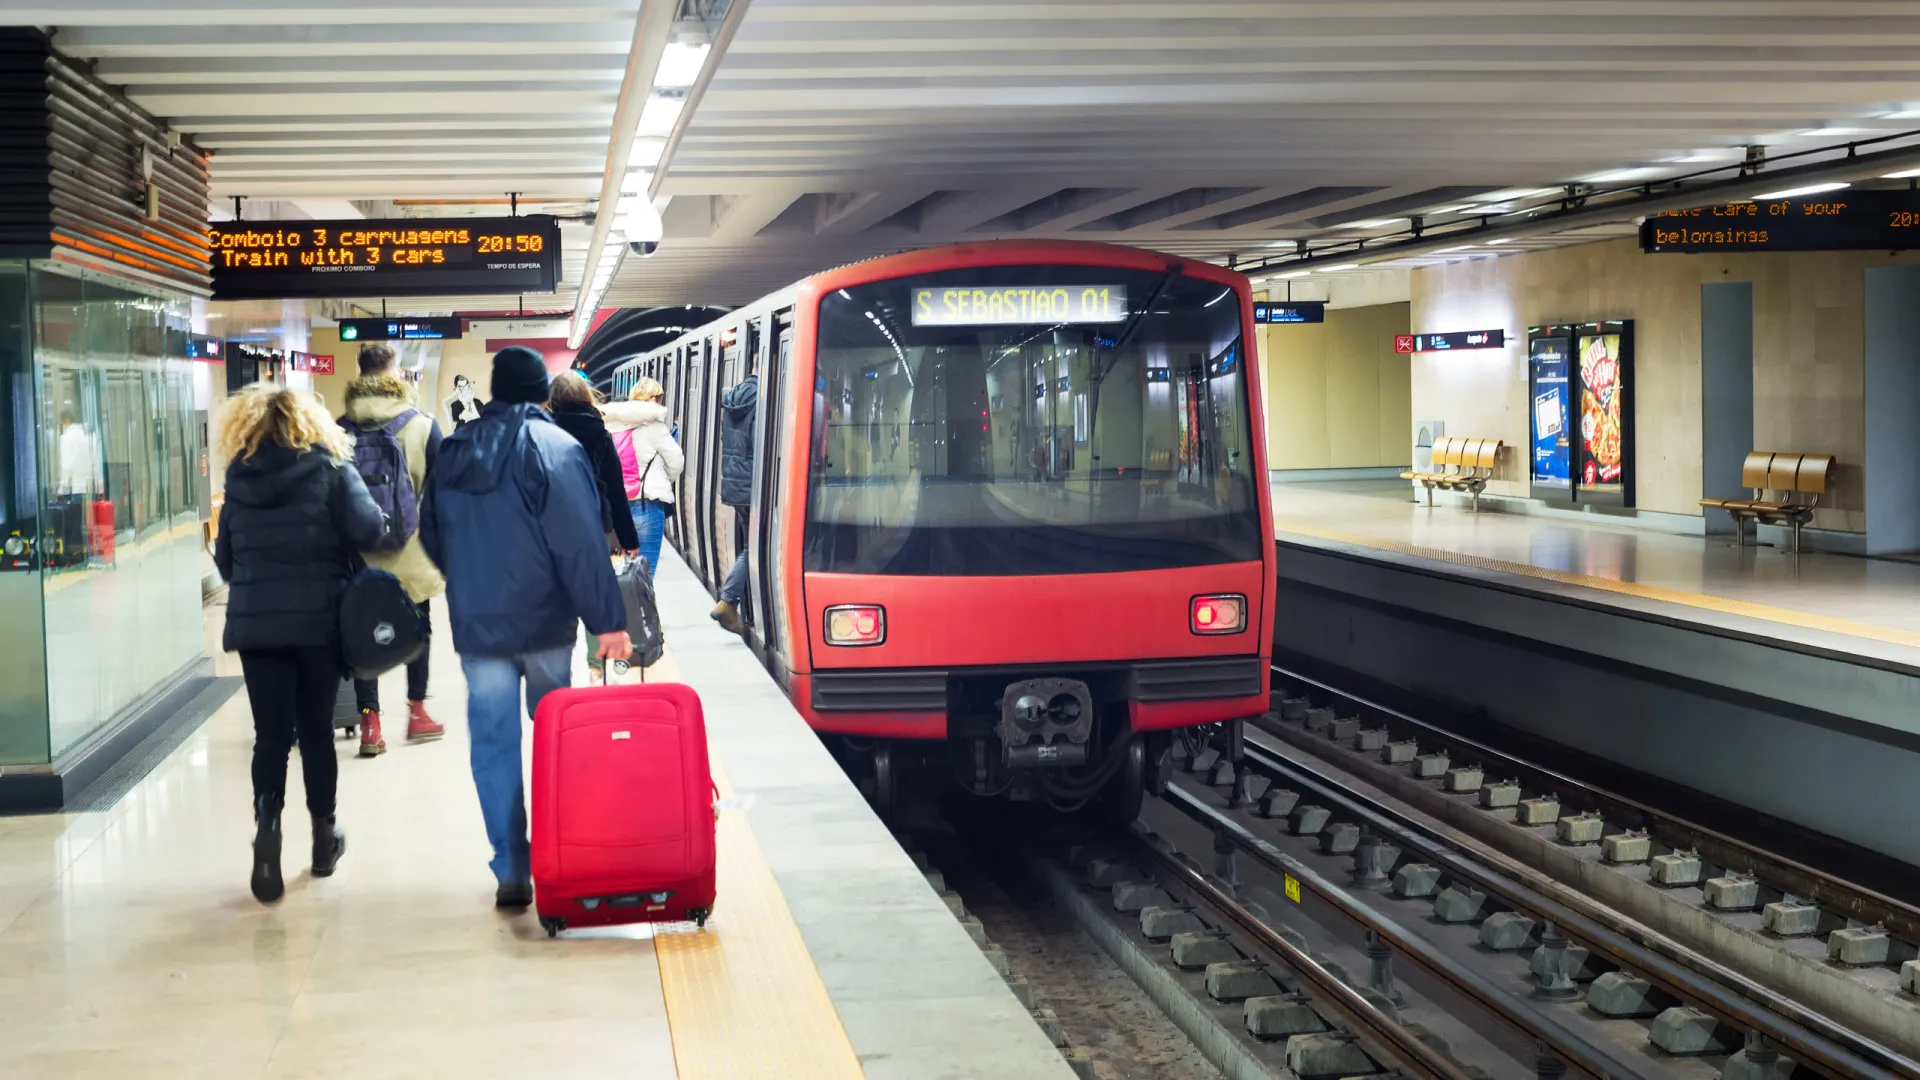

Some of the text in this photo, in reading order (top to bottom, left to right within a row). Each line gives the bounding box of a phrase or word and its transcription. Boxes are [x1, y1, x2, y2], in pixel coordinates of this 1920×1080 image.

[1713, 203, 1759, 217] care
[1769, 201, 1790, 216] of
[1803, 203, 1848, 216] your
[208, 229, 471, 248] Comboio 3 carruagens
[477, 235, 543, 253] 20:50
[1656, 228, 1769, 244] belongings
[222, 247, 445, 267] Train with 3 cars
[517, 262, 541, 270] ESPERA
[1080, 287, 1109, 318] 01
